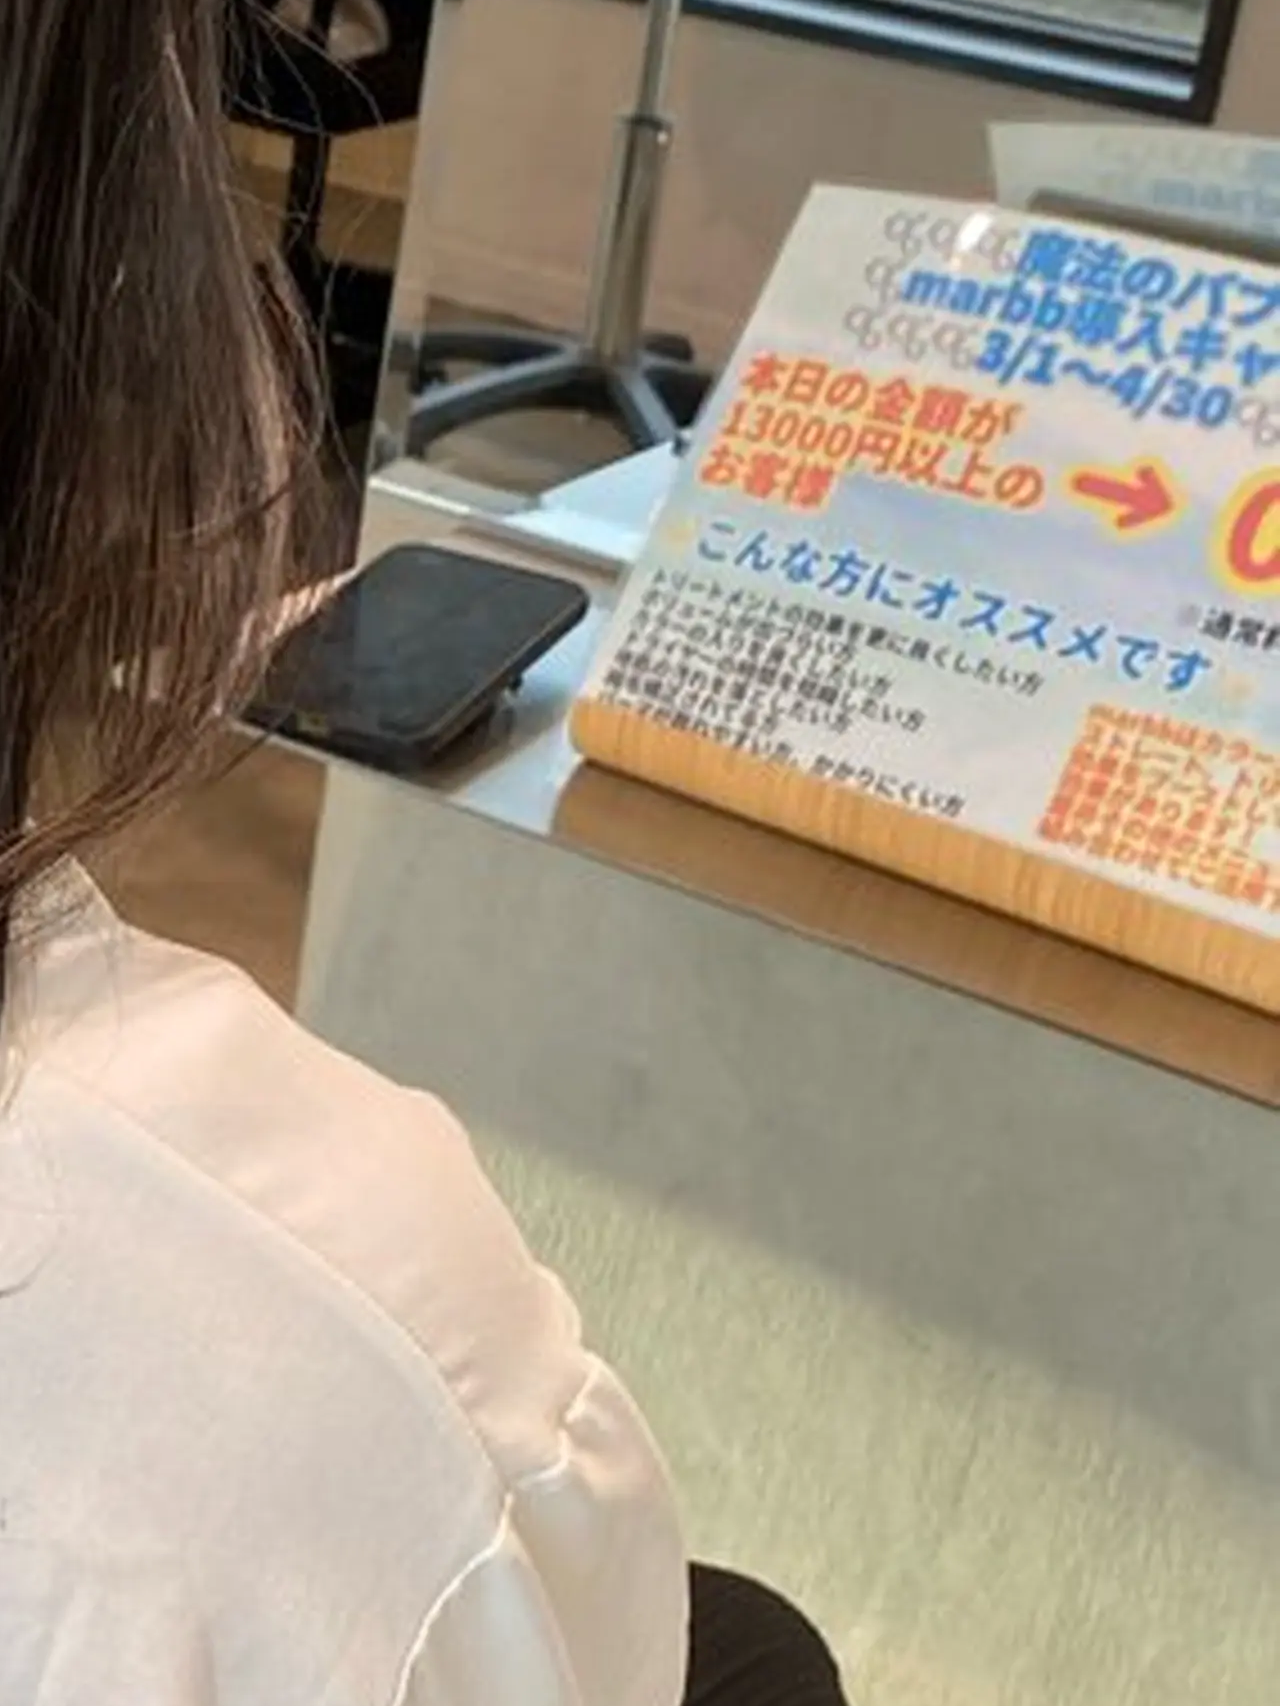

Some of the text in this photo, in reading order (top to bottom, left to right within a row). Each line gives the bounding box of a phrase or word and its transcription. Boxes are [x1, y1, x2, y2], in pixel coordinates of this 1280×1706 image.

[742, 350, 1024, 444] 本日の金額が
[699, 444, 834, 507] お客様
[721, 400, 1044, 508] 13000円以上の
[697, 521, 1213, 693] こんな方にオススメです
